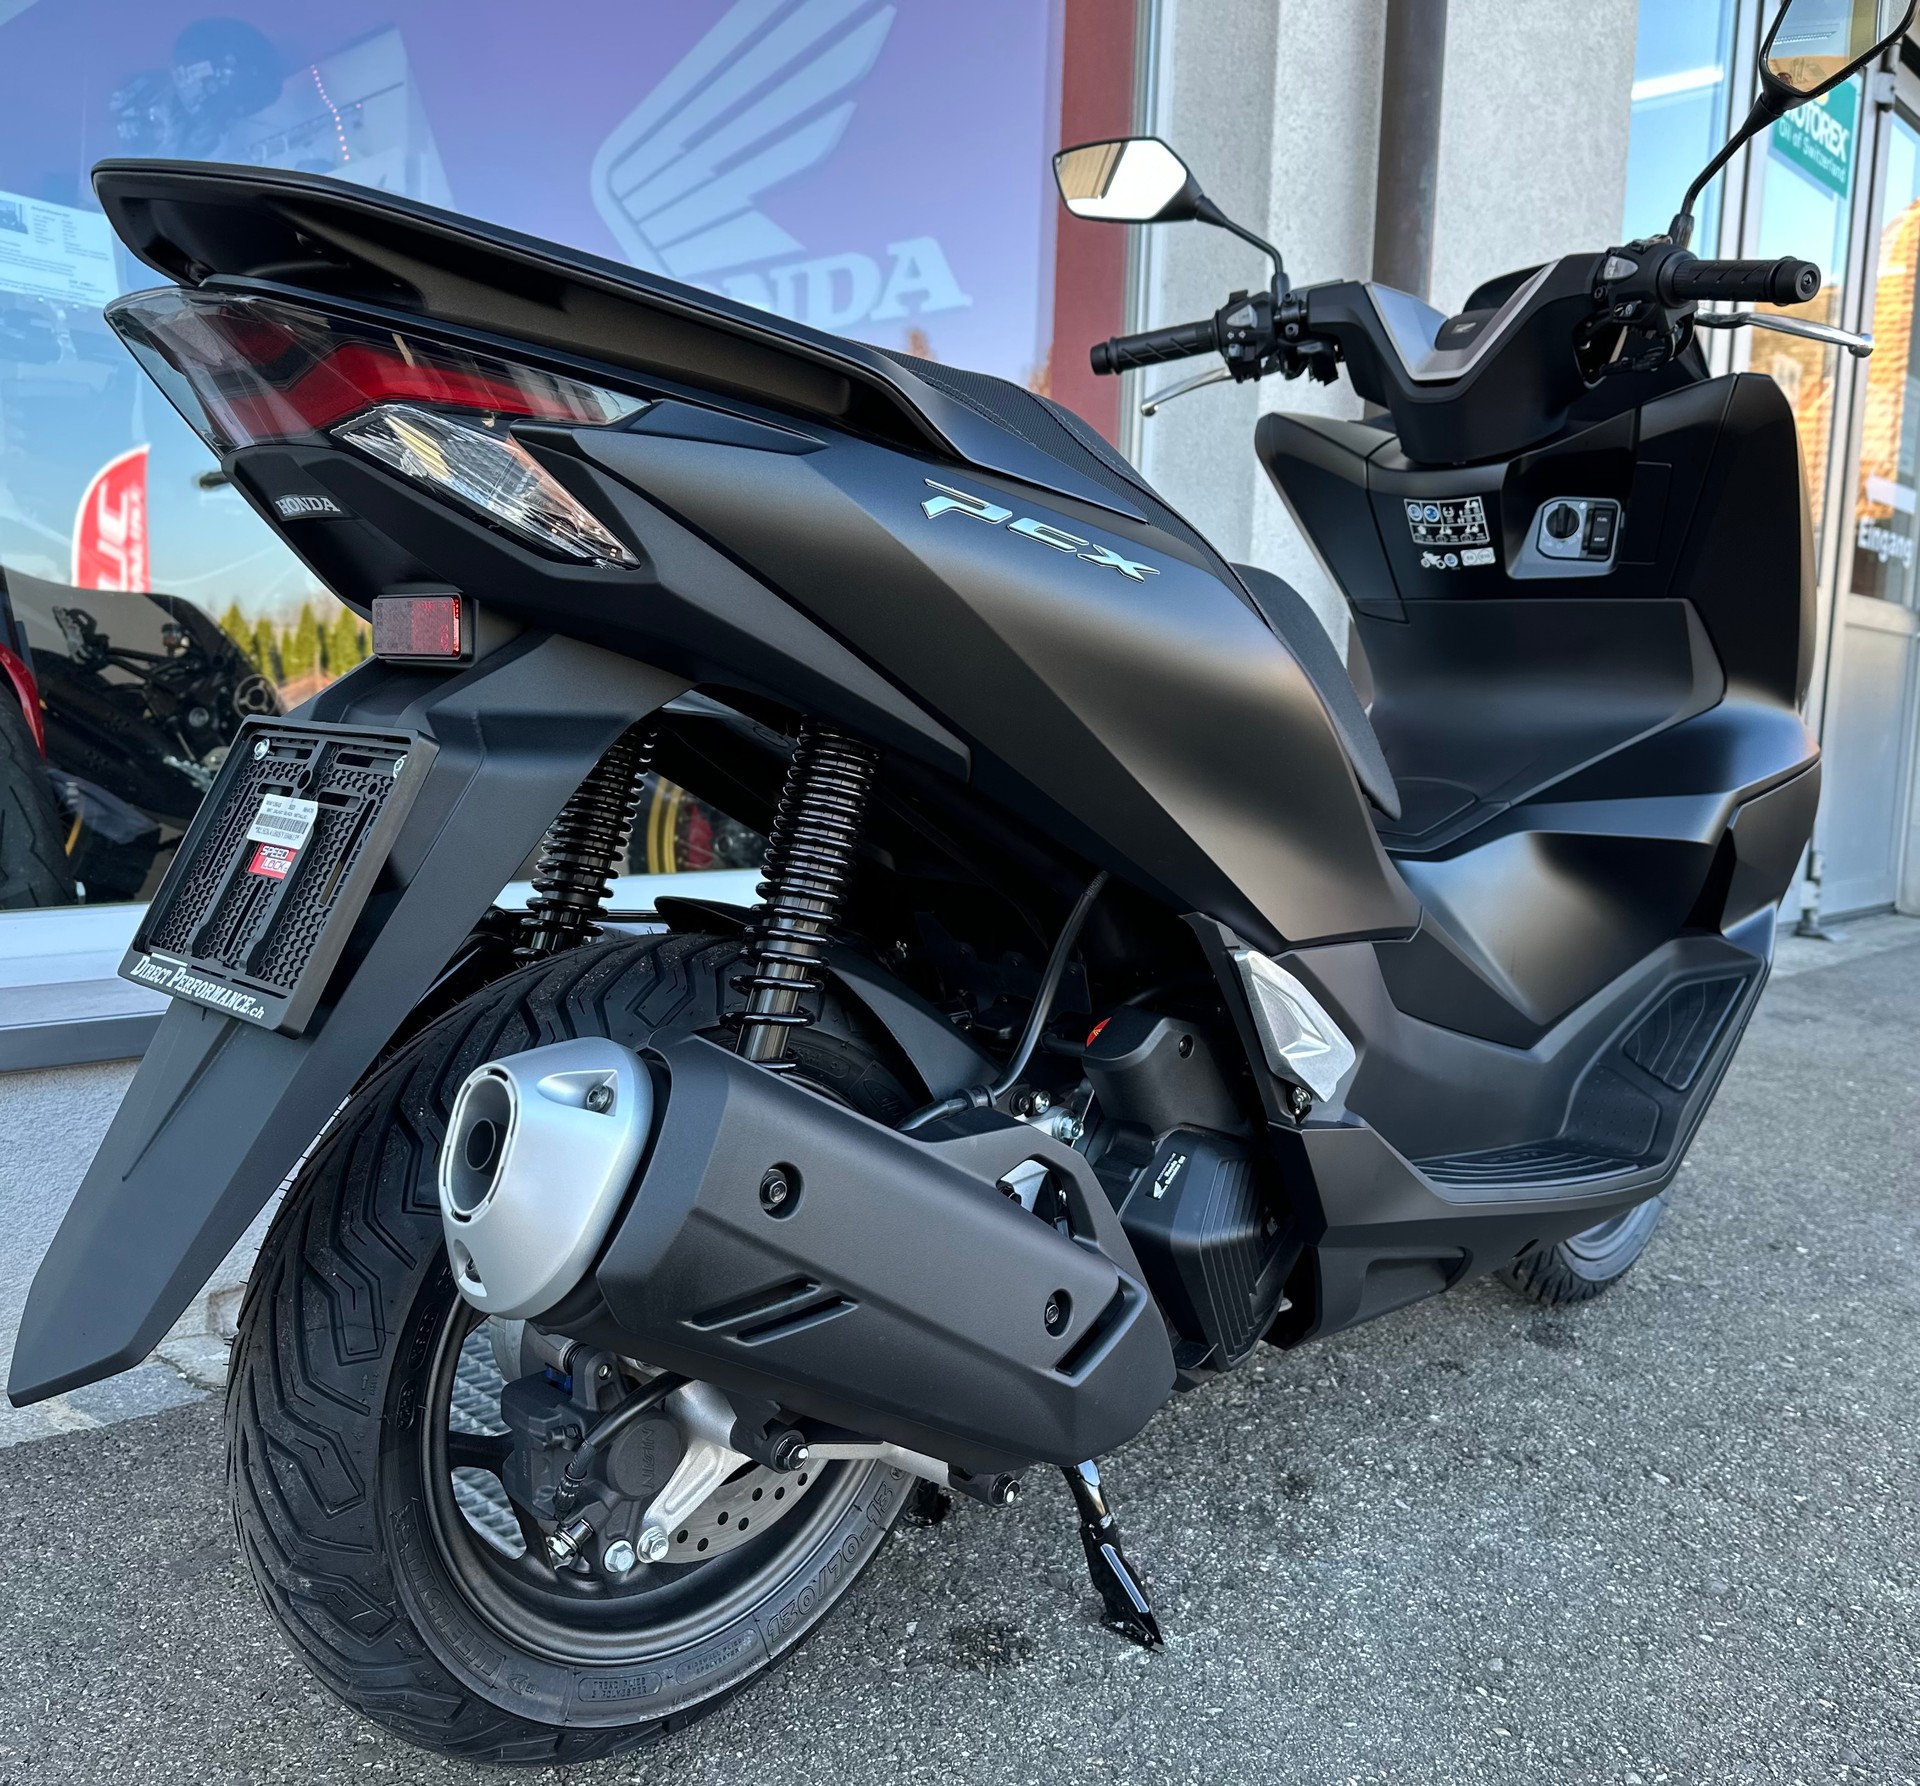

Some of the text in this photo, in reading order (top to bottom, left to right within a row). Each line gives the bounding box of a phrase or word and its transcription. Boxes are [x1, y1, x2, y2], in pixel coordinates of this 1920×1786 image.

[1778, 119, 1846, 183] Oil of Switzerland
[687, 235, 973, 331] NDA
[275, 496, 341, 515] HONDA
[921, 478, 1160, 583] PCX
[1857, 516, 1913, 569] Eingang
[260, 845, 290, 860] SPEED
[262, 858, 286, 871] LOCK
[404, 1550, 502, 1677] MICHELIN
